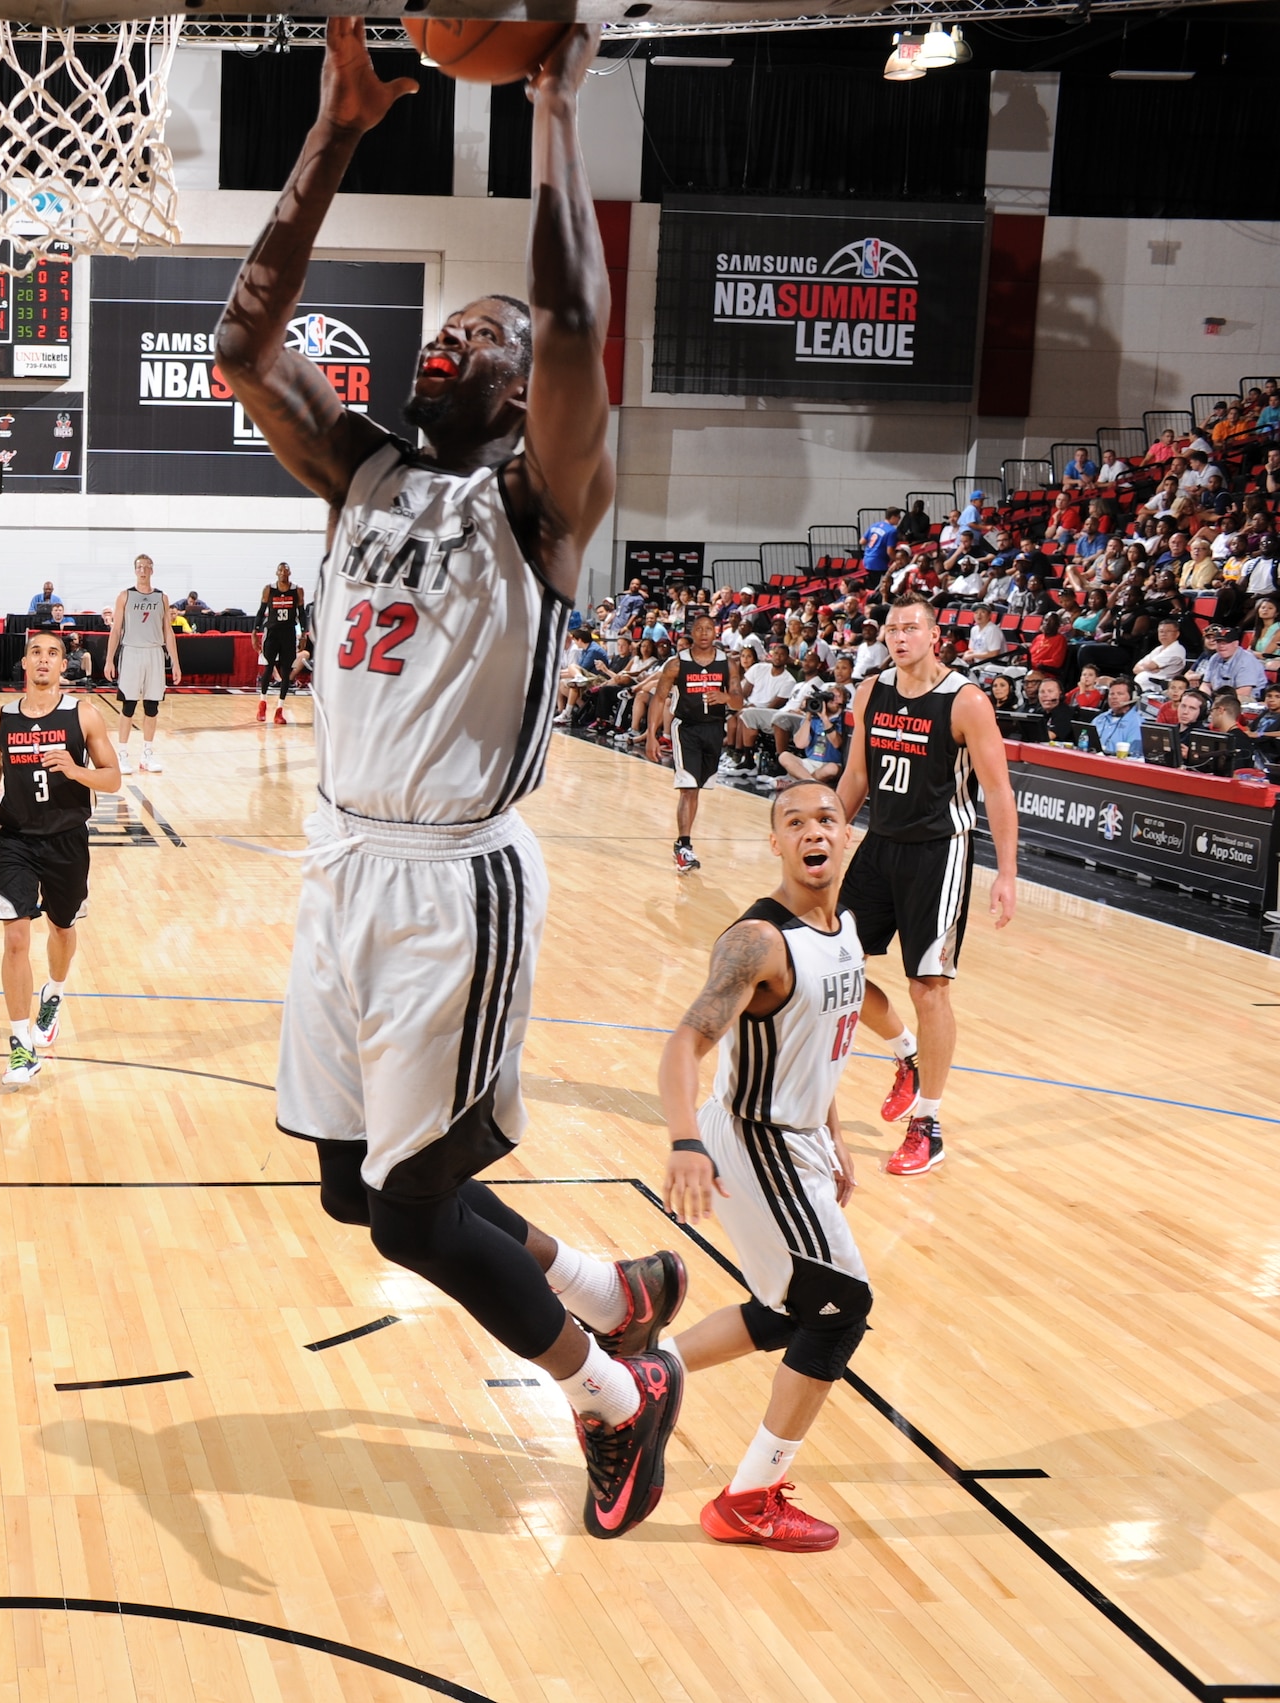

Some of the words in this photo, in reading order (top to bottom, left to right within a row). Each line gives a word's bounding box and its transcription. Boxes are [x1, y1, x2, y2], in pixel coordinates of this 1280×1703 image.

[54, 242, 70, 250] PTS
[716, 254, 818, 274] SAMSUNG
[38, 270, 47, 284] 0
[60, 271, 69, 284] 2
[39, 289, 47, 302] 3
[61, 289, 69, 302] 7
[714, 281, 776, 317] NBA
[776, 283, 918, 322] SUMMER
[17, 307, 34, 320] 33
[60, 307, 68, 320] 3
[17, 326, 33, 338] 35
[38, 325, 46, 338] 2
[60, 326, 68, 338] 6
[795, 320, 915, 358] LEAGUE
[140, 362, 211, 398] NBA
[134, 601, 159, 610] HEAT
[277, 609, 288, 621] 33
[142, 612, 150, 623] 7
[338, 600, 419, 676] 32
[686, 673, 722, 682] HOUSTON
[873, 711, 932, 734] HOUSTON
[8, 730, 66, 744] HOUSTON
[870, 737, 928, 756] BASKETBALL
[10, 754, 45, 764] BASKET
[878, 754, 911, 794] 20
[33, 770, 49, 802] 3
[1017, 791, 1065, 822] LEAGUE
[1066, 802, 1095, 828] APP
[1142, 828, 1168, 846] Google
[1168, 835, 1182, 849] play
[1212, 834, 1236, 846] Download
[1244, 840, 1254, 850] the
[1210, 844, 1228, 861] App
[1229, 848, 1253, 864] Store
[831, 1010, 859, 1062] 13
